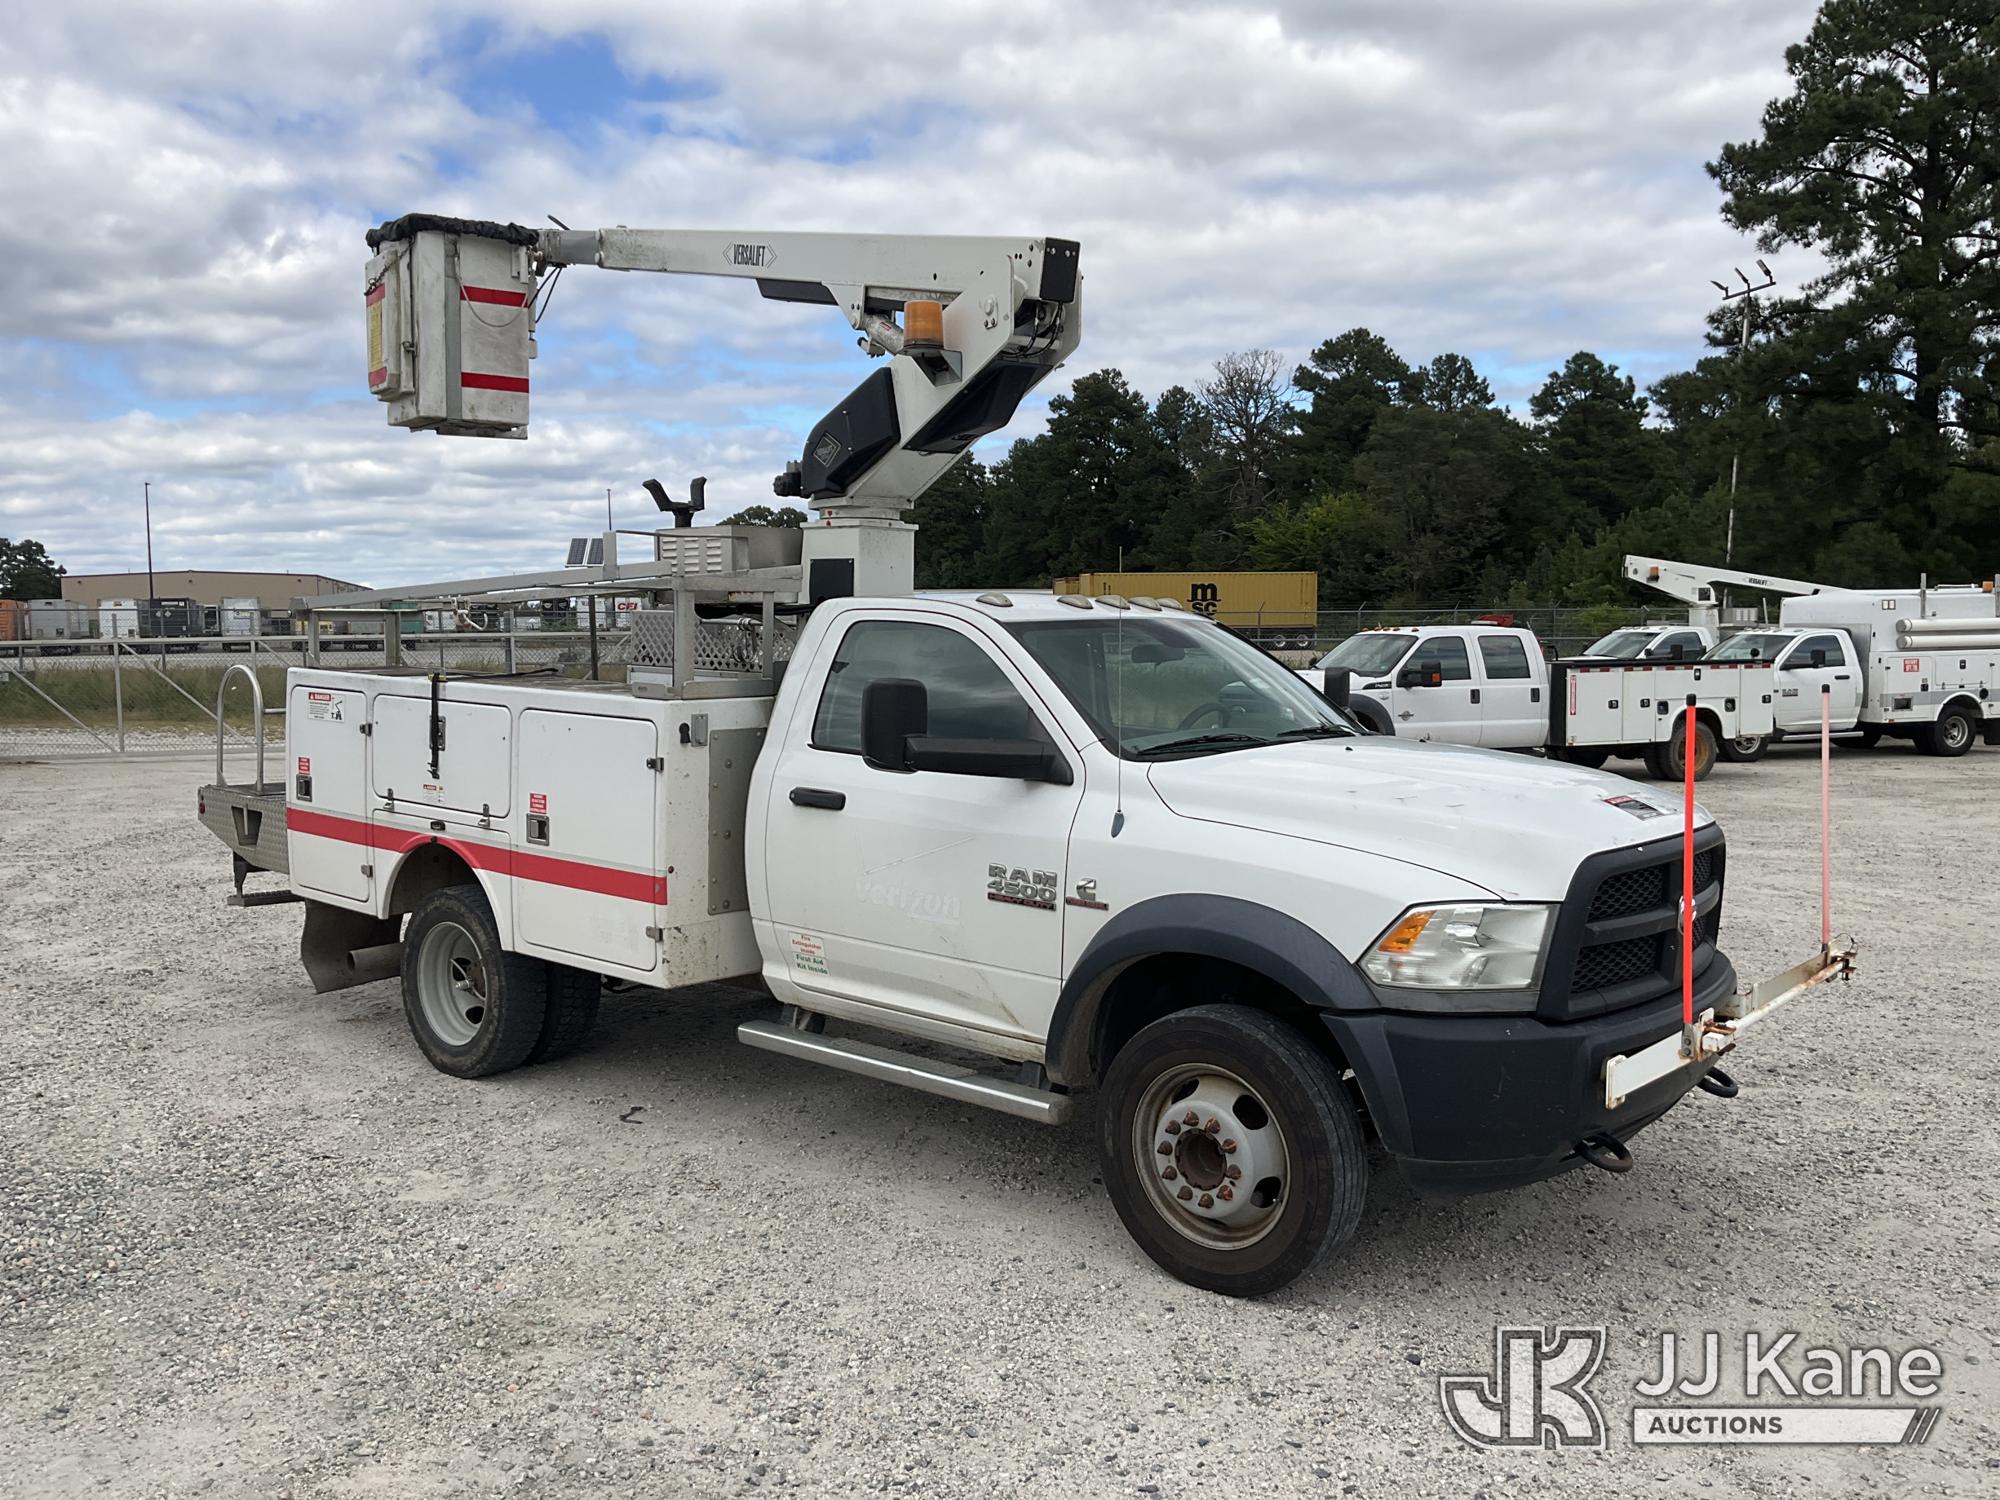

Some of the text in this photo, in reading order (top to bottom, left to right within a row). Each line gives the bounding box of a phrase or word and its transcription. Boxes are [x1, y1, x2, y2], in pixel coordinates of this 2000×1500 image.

[733, 244, 765, 267] VERSALIFT
[617, 602, 638, 610] CFI
[988, 863, 1057, 887] RAM
[987, 879, 1056, 902] 4500
[989, 893, 1024, 906] HEAVY
[1024, 899, 1053, 910] DUTY
[796, 954, 811, 962] First
[808, 965, 828, 974] Inside
